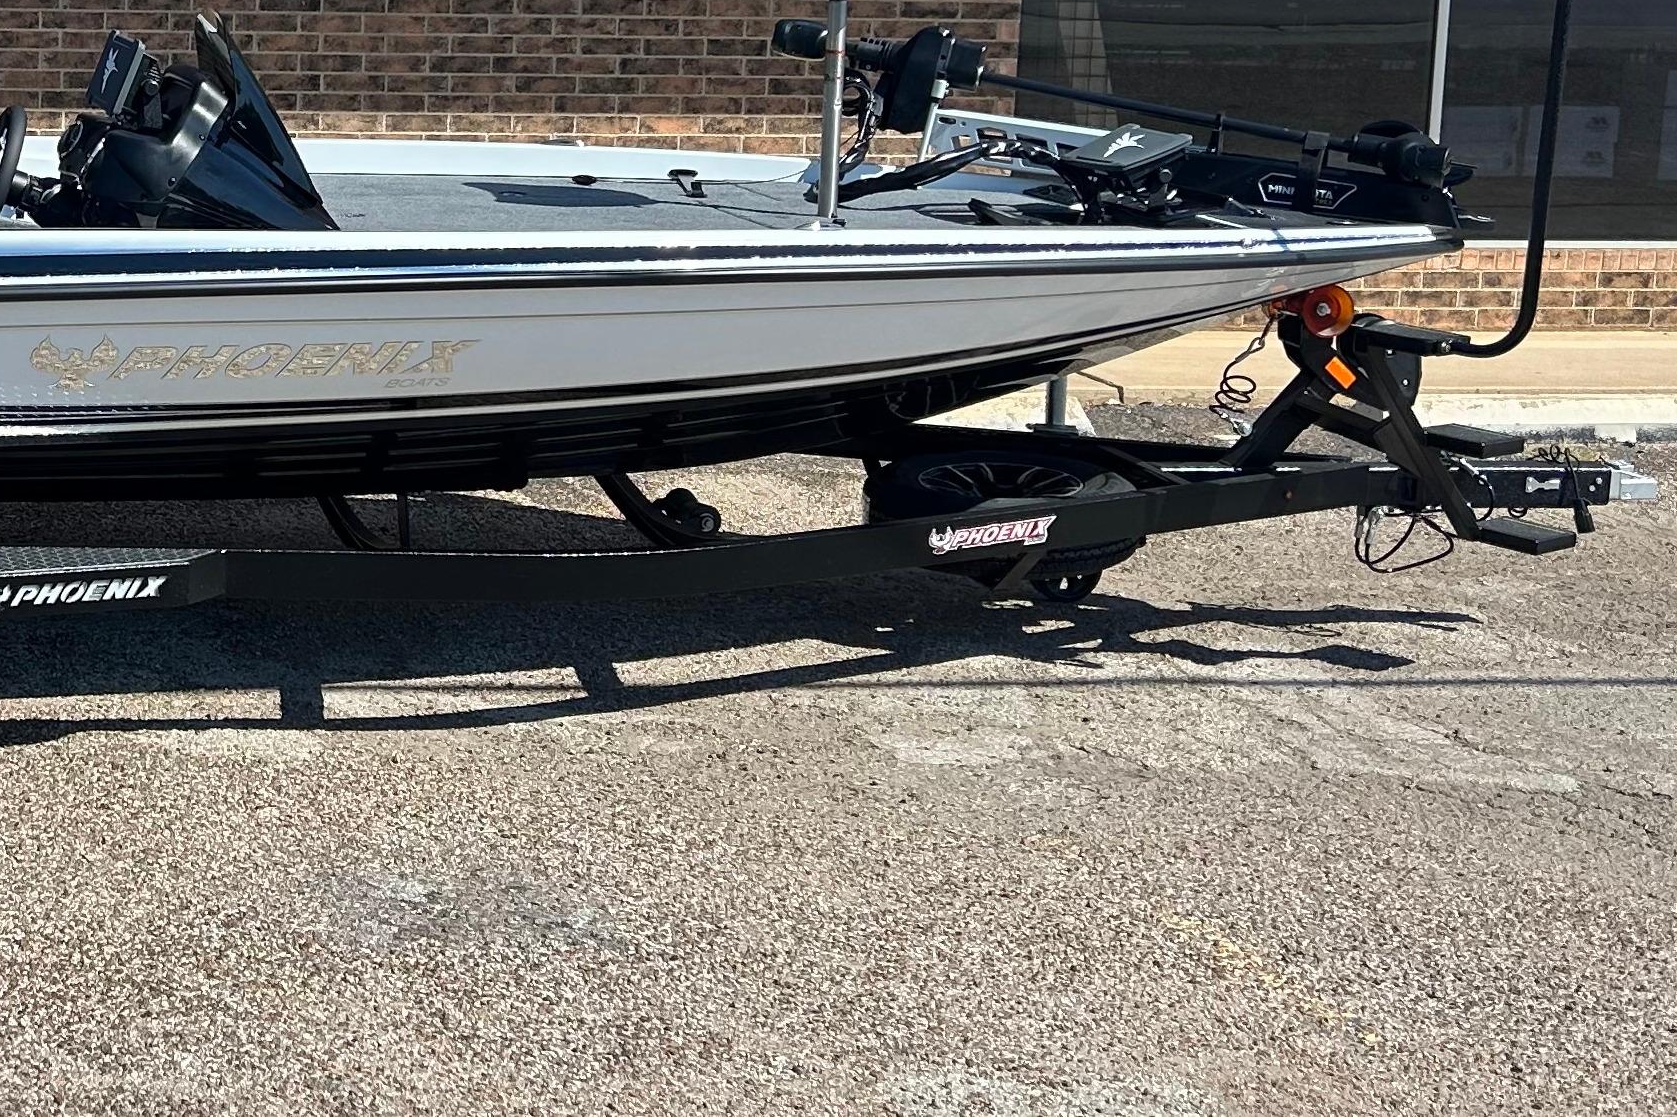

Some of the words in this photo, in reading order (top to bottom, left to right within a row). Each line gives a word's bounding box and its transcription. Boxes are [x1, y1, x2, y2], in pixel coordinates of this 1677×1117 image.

[107, 339, 482, 379] PHOENIX
[384, 376, 451, 389] BOATS
[951, 517, 1053, 547] PHOENIX
[10, 575, 169, 607] PHOENIX
